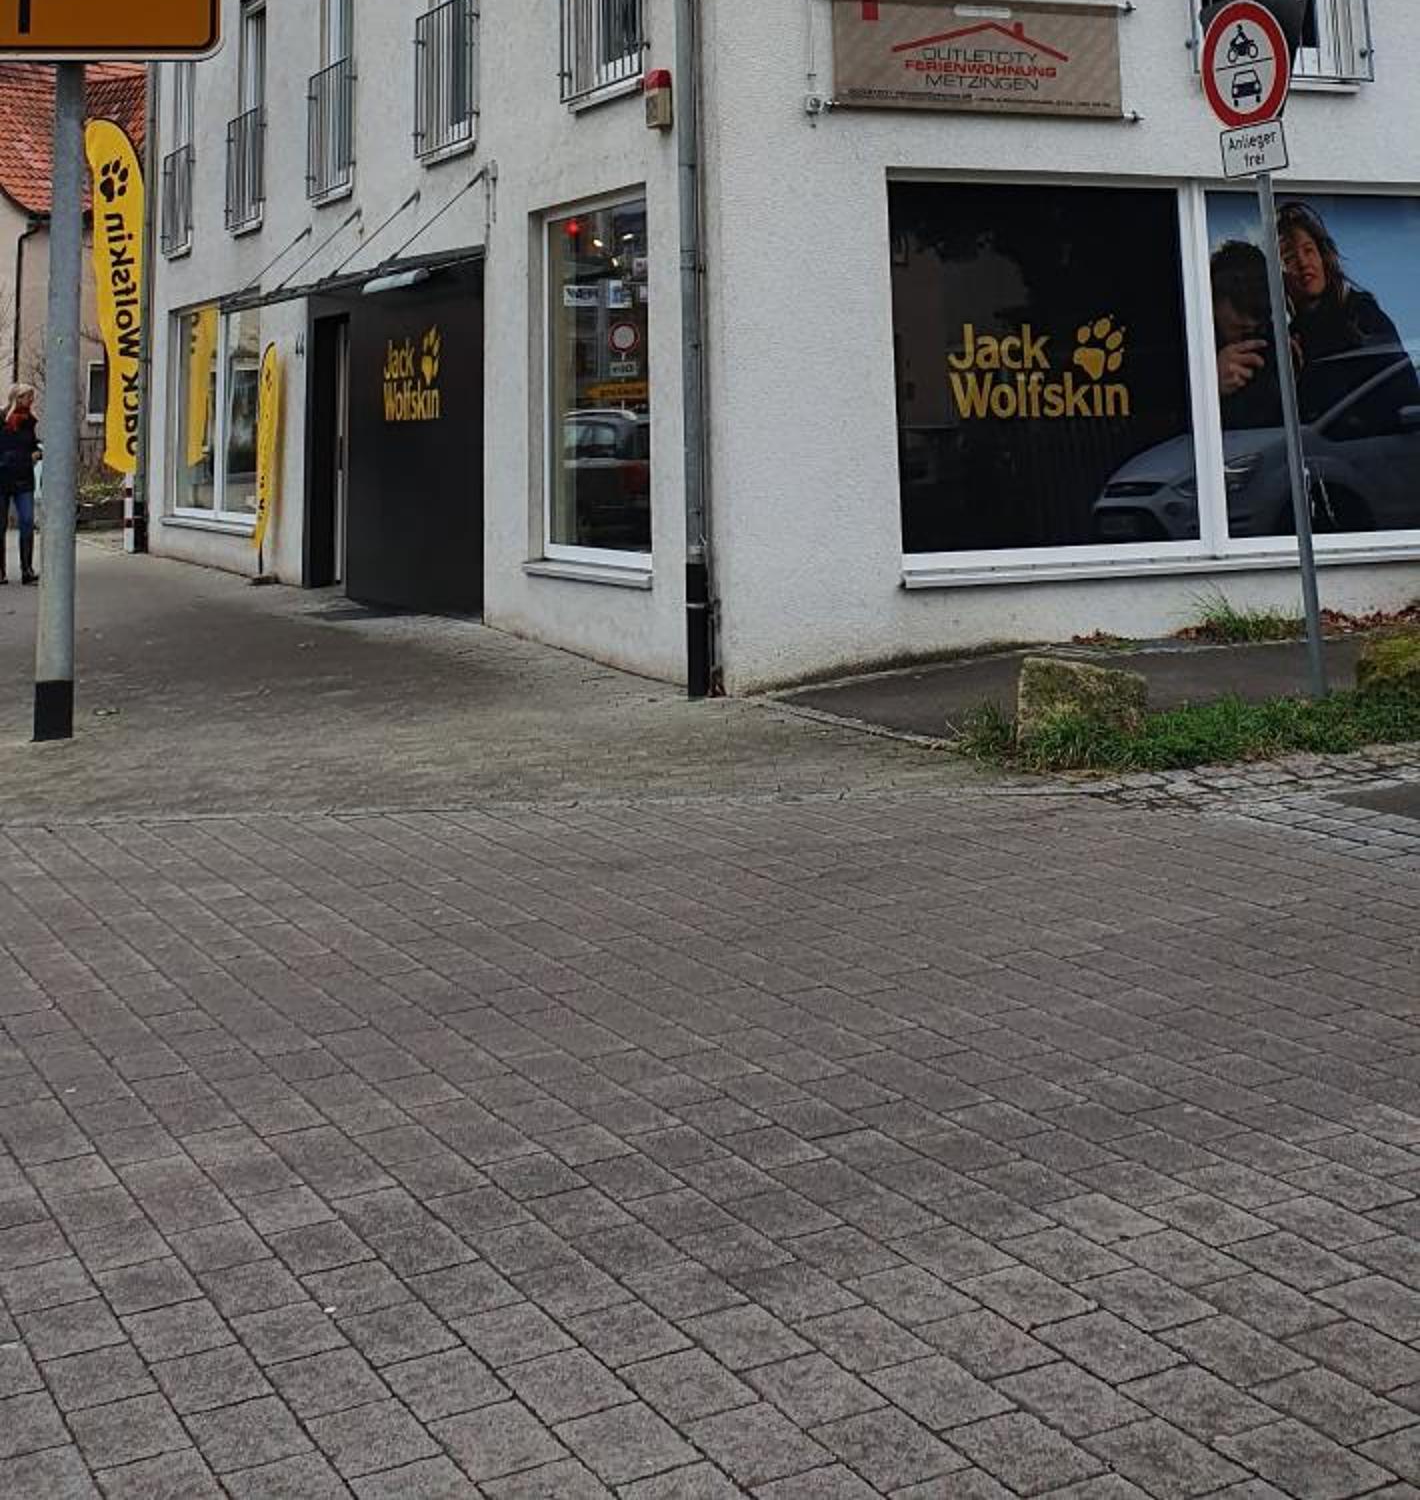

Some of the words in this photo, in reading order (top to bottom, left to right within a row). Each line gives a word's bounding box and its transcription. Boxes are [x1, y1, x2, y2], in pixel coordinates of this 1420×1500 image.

[922, 46, 1038, 64] OUTLETCITY
[904, 59, 1057, 79] FERIENWOHNUNG
[924, 73, 1039, 92] METZINGEN
[1228, 130, 1277, 151] Anlieger
[1244, 151, 1266, 168] frei
[948, 323, 1051, 370] Jack
[384, 338, 416, 378] Jack
[383, 376, 440, 421] Wolfskin
[949, 371, 1131, 419] Wolfskin
